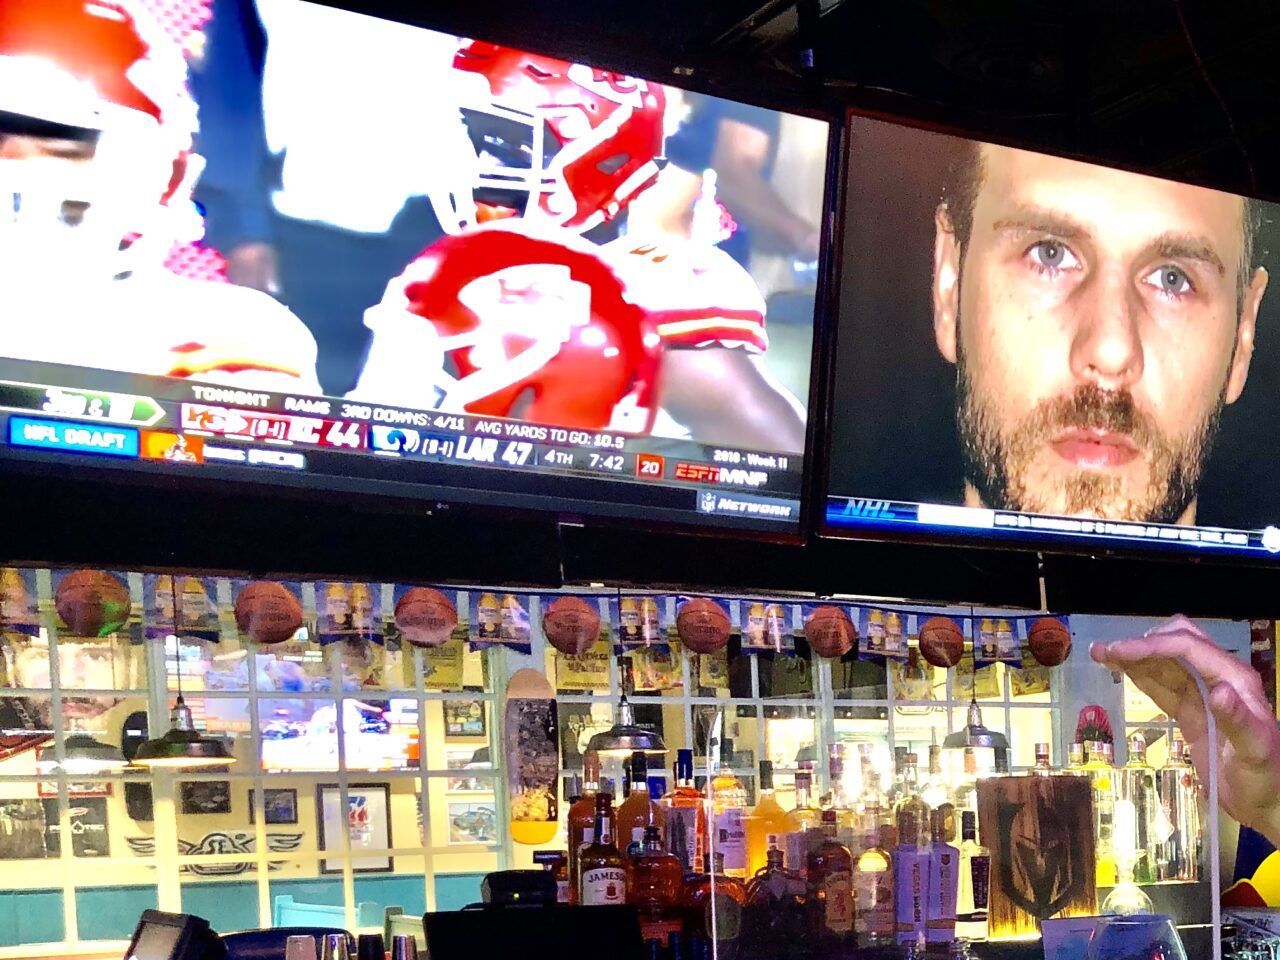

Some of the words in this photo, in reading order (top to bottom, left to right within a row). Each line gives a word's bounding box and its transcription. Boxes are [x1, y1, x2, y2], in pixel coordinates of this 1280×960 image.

[192, 386, 271, 407] TONIGHT
[285, 397, 332, 415] RAMS
[341, 404, 372, 420] 3RD
[373, 407, 431, 427] DOWNS:
[433, 416, 465, 431] 4/11
[475, 421, 503, 435] AVG
[505, 424, 548, 440] YARDS
[550, 428, 568, 445] TO
[569, 432, 592, 446] GO:
[594, 434, 626, 449] 10.5
[23, 424, 60, 444] NFL
[64, 426, 126, 449] DRAFT
[325, 422, 361, 449] 44
[455, 435, 499, 462] LAR
[502, 441, 533, 466] 47
[544, 452, 574, 465] 4TH
[590, 453, 625, 470] 7:42
[640, 460, 660, 475] 20
[747, 453, 777, 469] Week
[843, 499, 896, 519] NHL
